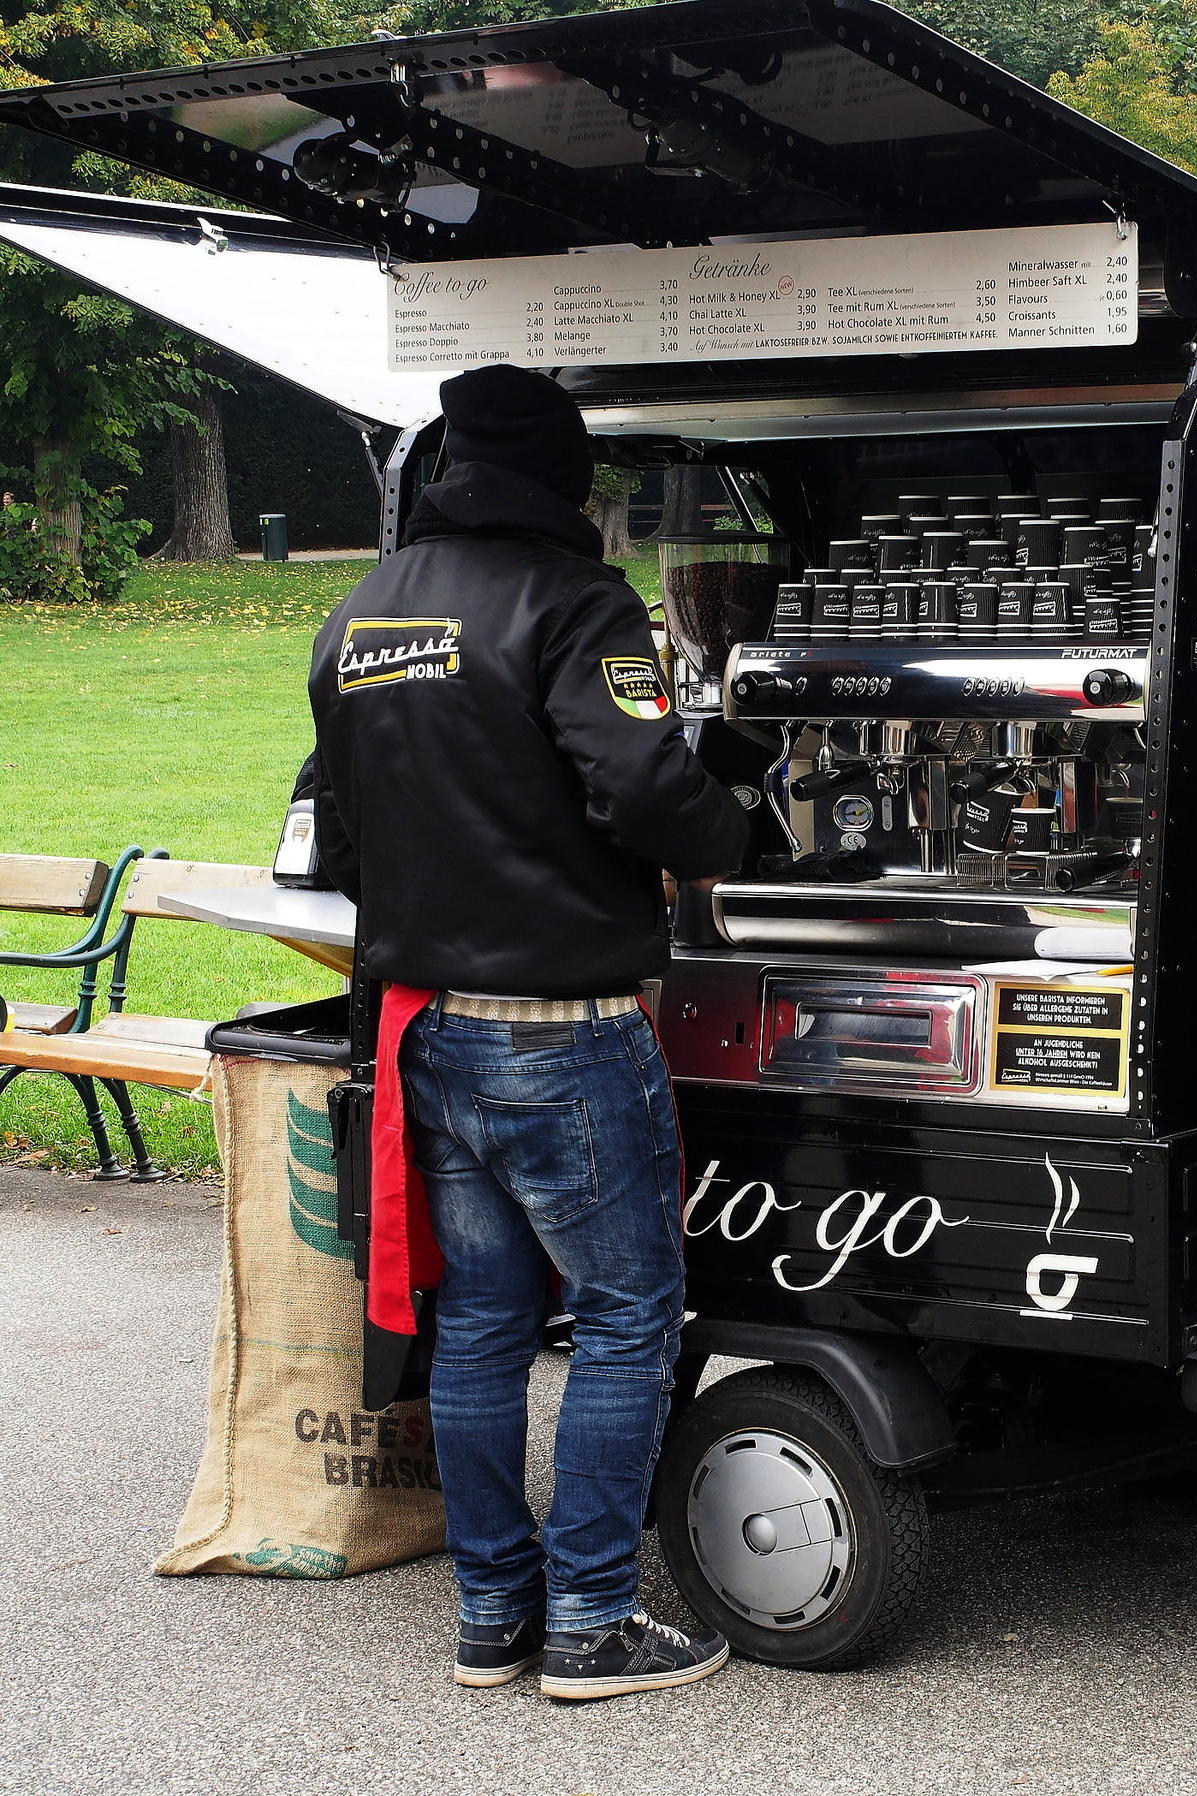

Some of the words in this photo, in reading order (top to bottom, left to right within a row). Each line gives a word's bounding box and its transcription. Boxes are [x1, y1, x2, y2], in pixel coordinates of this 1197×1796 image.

[689, 253, 772, 280] Getränke
[1008, 260, 1079, 272] Mineralwasser
[1106, 256, 1128, 268] 2,40
[394, 271, 442, 303] Coffee
[446, 277, 461, 293] to
[459, 278, 489, 300] go
[554, 284, 602, 296] Cappuccino
[660, 280, 678, 290] 3,70
[828, 287, 843, 297] Tee
[846, 287, 858, 296] XL
[976, 279, 996, 291] 2,60
[1008, 277, 1050, 288] Himbeer
[1052, 275, 1072, 286] Saft
[1075, 275, 1087, 285] XL
[1106, 273, 1128, 285] 2,40
[554, 300, 602, 312] Cappuccino
[604, 299, 614, 308] XL
[660, 295, 678, 306] 4,30
[689, 295, 705, 304] Hot
[708, 293, 726, 303] Milk
[730, 293, 736, 302] &
[739, 291, 767, 303] Honey
[769, 290, 780, 300] XL
[798, 289, 816, 300] 2,90
[828, 303, 843, 313] Tee
[846, 303, 861, 312] mit
[864, 302, 884, 311] Rum
[887, 301, 899, 310] XL
[976, 296, 996, 308] 3,50
[1008, 294, 1048, 305] Flavours
[1106, 290, 1128, 302] 0,60
[395, 309, 427, 319] Espresso
[526, 302, 544, 313] 2,20
[554, 317, 575, 326] Latte
[577, 314, 620, 324] Macchiato
[623, 313, 634, 322] XL
[660, 311, 678, 321] 4,10
[689, 309, 708, 320] Chai
[711, 309, 733, 318] Latte
[735, 308, 747, 317] XL
[798, 305, 816, 315] 3,90
[1008, 310, 1056, 321] Croissants
[1107, 307, 1127, 318] 1,95
[395, 324, 427, 334] Espresso
[429, 322, 470, 332] Macchiato
[526, 317, 544, 328] 2,40
[689, 326, 705, 335] Hot
[707, 323, 751, 334] Chocolate
[753, 322, 765, 332] XL
[798, 321, 816, 331] 3,90
[828, 320, 844, 329] Hot
[847, 317, 893, 328] Chocolate
[895, 317, 906, 326] XL
[910, 316, 925, 325] mit
[928, 315, 949, 324] Rum
[976, 312, 996, 324] 4,50
[554, 331, 591, 342] Melange
[660, 326, 678, 337] 3,70
[1008, 327, 1045, 338] Manner
[1049, 325, 1095, 336] Schnitten
[1107, 323, 1128, 334] 1,60
[395, 339, 427, 349] Espresso
[430, 336, 458, 348] Doppio
[526, 333, 544, 344] 3,80
[755, 337, 809, 348] LAKTOSEFREIER
[811, 336, 830, 345] BZW.
[832, 335, 873, 345] SOJAMILCH
[874, 334, 899, 343] SOWIE
[900, 331, 968, 342] ENTKOFFEINIERTEM
[395, 354, 427, 364] Espresso
[430, 352, 463, 362] Corretto
[464, 351, 478, 360] mit
[480, 350, 509, 361] Grappa
[526, 348, 544, 359] 4,10
[555, 346, 606, 357] Verlängerter
[660, 342, 678, 353] 3,40
[338, 637, 459, 676] Espresso
[1061, 648, 1137, 659] FUTURMAT
[406, 663, 447, 679] MOBIL
[625, 688, 657, 698] BARISTA
[1016, 993, 1038, 1002] UNSERE
[1039, 994, 1064, 1003] BARISTA
[1066, 996, 1106, 1005] INFORMIEREN
[1012, 1002, 1022, 1011] SIE
[1023, 1002, 1038, 1012] ÜBER
[1074, 1006, 1100, 1015] ZUTATEN
[1101, 1007, 1108, 1015] IN
[1027, 1014, 1053, 1022] UNSEREN
[1033, 1039, 1043, 1047] AN
[1043, 1040, 1084, 1049] JUGENDLICHE
[1015, 1048, 1035, 1057] UNTER
[1046, 1049, 1068, 1058] JAHREN
[1069, 1050, 1086, 1059] WIRD
[1086, 1051, 1101, 1060] KEIN
[1018, 1057, 1048, 1066] ALKOHOL
[683, 1160, 802, 1241] to
[772, 1190, 970, 1291] go
[295, 1408, 424, 1449] CAFÉS
